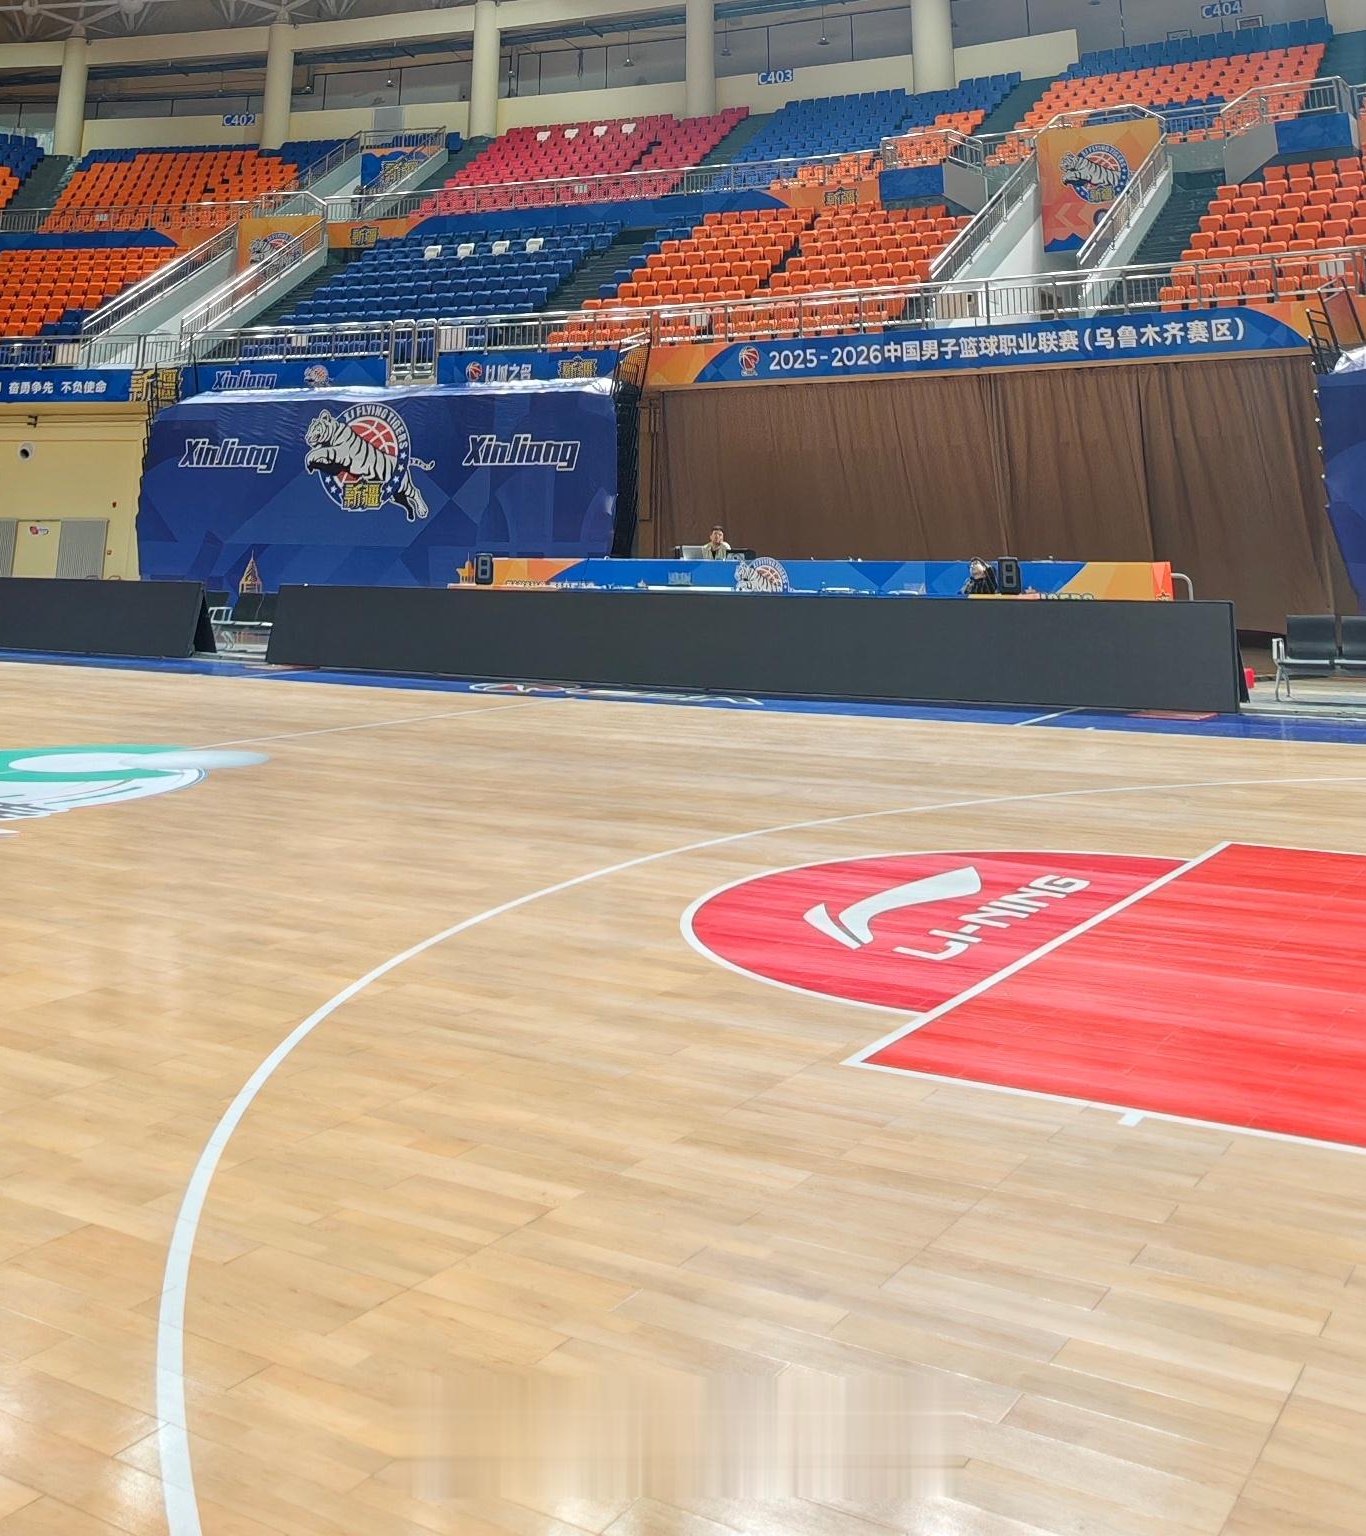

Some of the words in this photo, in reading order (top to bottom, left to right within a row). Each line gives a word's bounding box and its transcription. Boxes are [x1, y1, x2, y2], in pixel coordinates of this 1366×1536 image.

[1201, 0, 1242, 19] C404
[758, 69, 793, 85] C403
[223, 113, 255, 126] C402
[8, 381, 54, 394] 奋勇争先
[60, 380, 108, 394] 不负使命
[212, 370, 277, 390] XinJiang
[355, 405, 389, 421] FLYING
[386, 412, 409, 451] TIGERS
[178, 437, 280, 474] XinJiang
[462, 433, 580, 471] XinJiang
[343, 482, 382, 509] 新疆
[893, 874, 1091, 962] LI-NING
